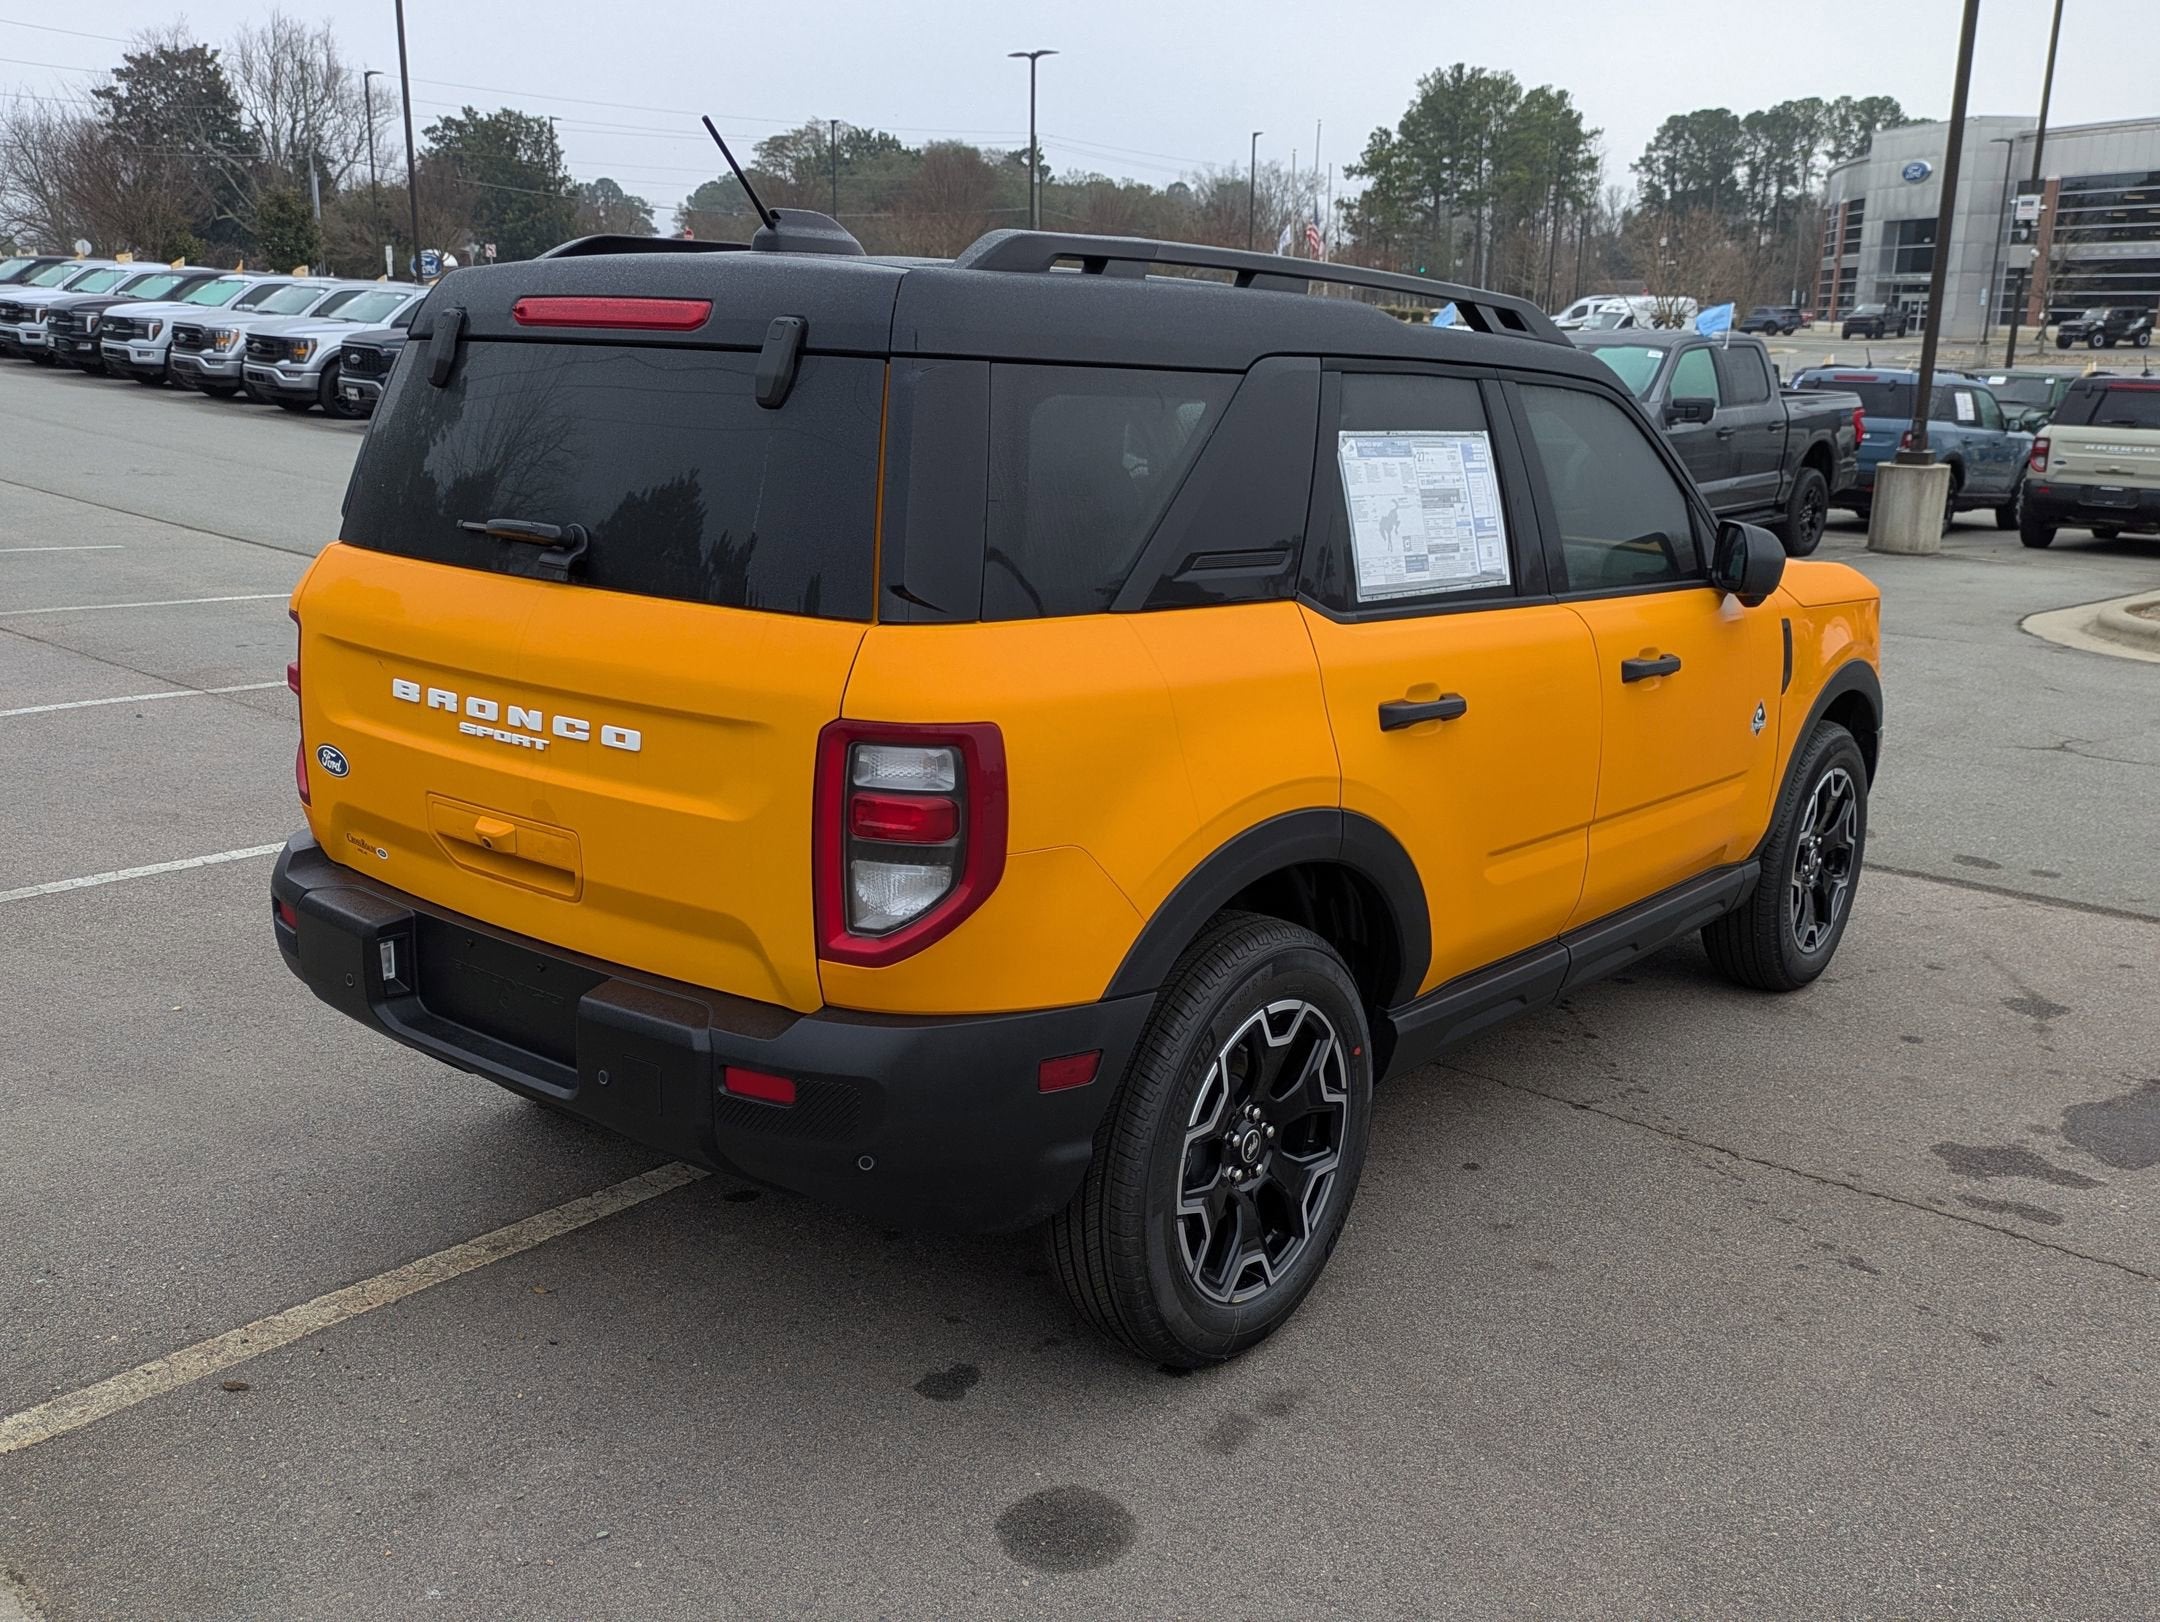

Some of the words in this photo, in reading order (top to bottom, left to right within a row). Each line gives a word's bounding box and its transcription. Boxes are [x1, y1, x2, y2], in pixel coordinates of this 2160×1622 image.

[392, 678, 642, 751] BRONCO
[459, 721, 550, 750] SPORT
[321, 749, 342, 772] Ford
